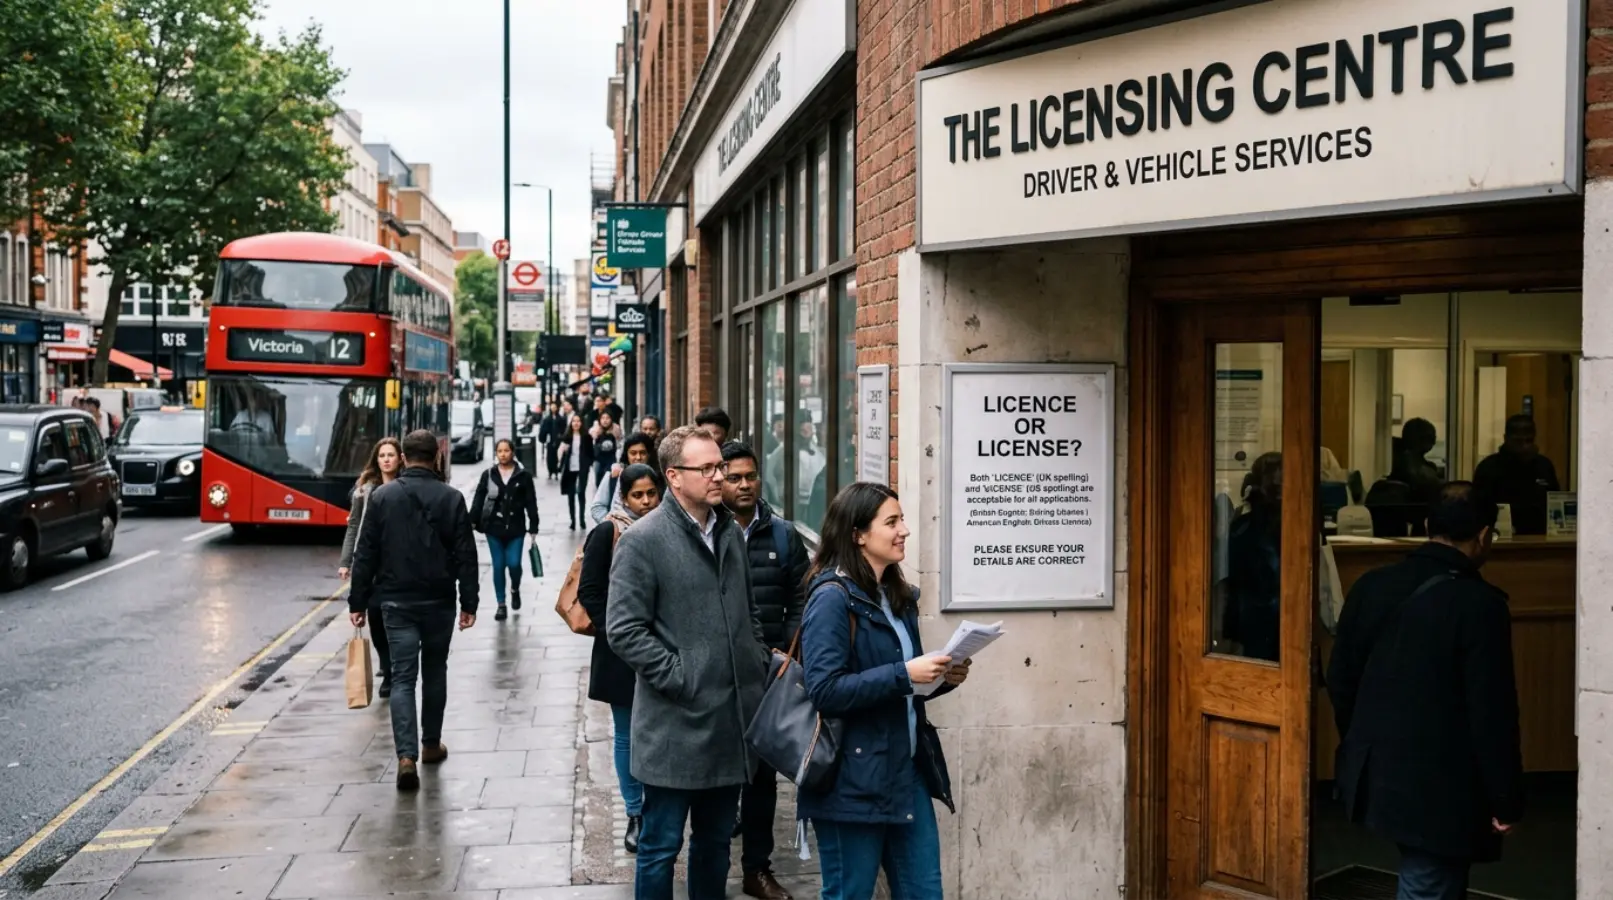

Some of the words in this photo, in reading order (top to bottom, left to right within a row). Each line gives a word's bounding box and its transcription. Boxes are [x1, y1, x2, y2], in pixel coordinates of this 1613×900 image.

[943, 106, 1001, 163] THE
[1010, 61, 1235, 154] LICENSING
[1252, 6, 1515, 114] CENTRE
[1023, 161, 1098, 199] DRIVER
[1104, 160, 1120, 188] &
[1125, 146, 1227, 187] VEHICLE
[1234, 126, 1373, 173] SERVICES
[248, 338, 304, 354] Victoria
[330, 338, 350, 359] 12
[984, 395, 1077, 413] LICENCE
[1014, 417, 1046, 435] OR
[978, 439, 1082, 457] LICENSE?
[970, 473, 990, 482] Both
[1036, 473, 1052, 483] (UK
[1013, 495, 1026, 503] for
[974, 545, 1012, 554] PLEASE
[1056, 544, 1084, 553] YOUR
[1015, 557, 1036, 565] ARE
[1038, 556, 1085, 565] CORRECT
